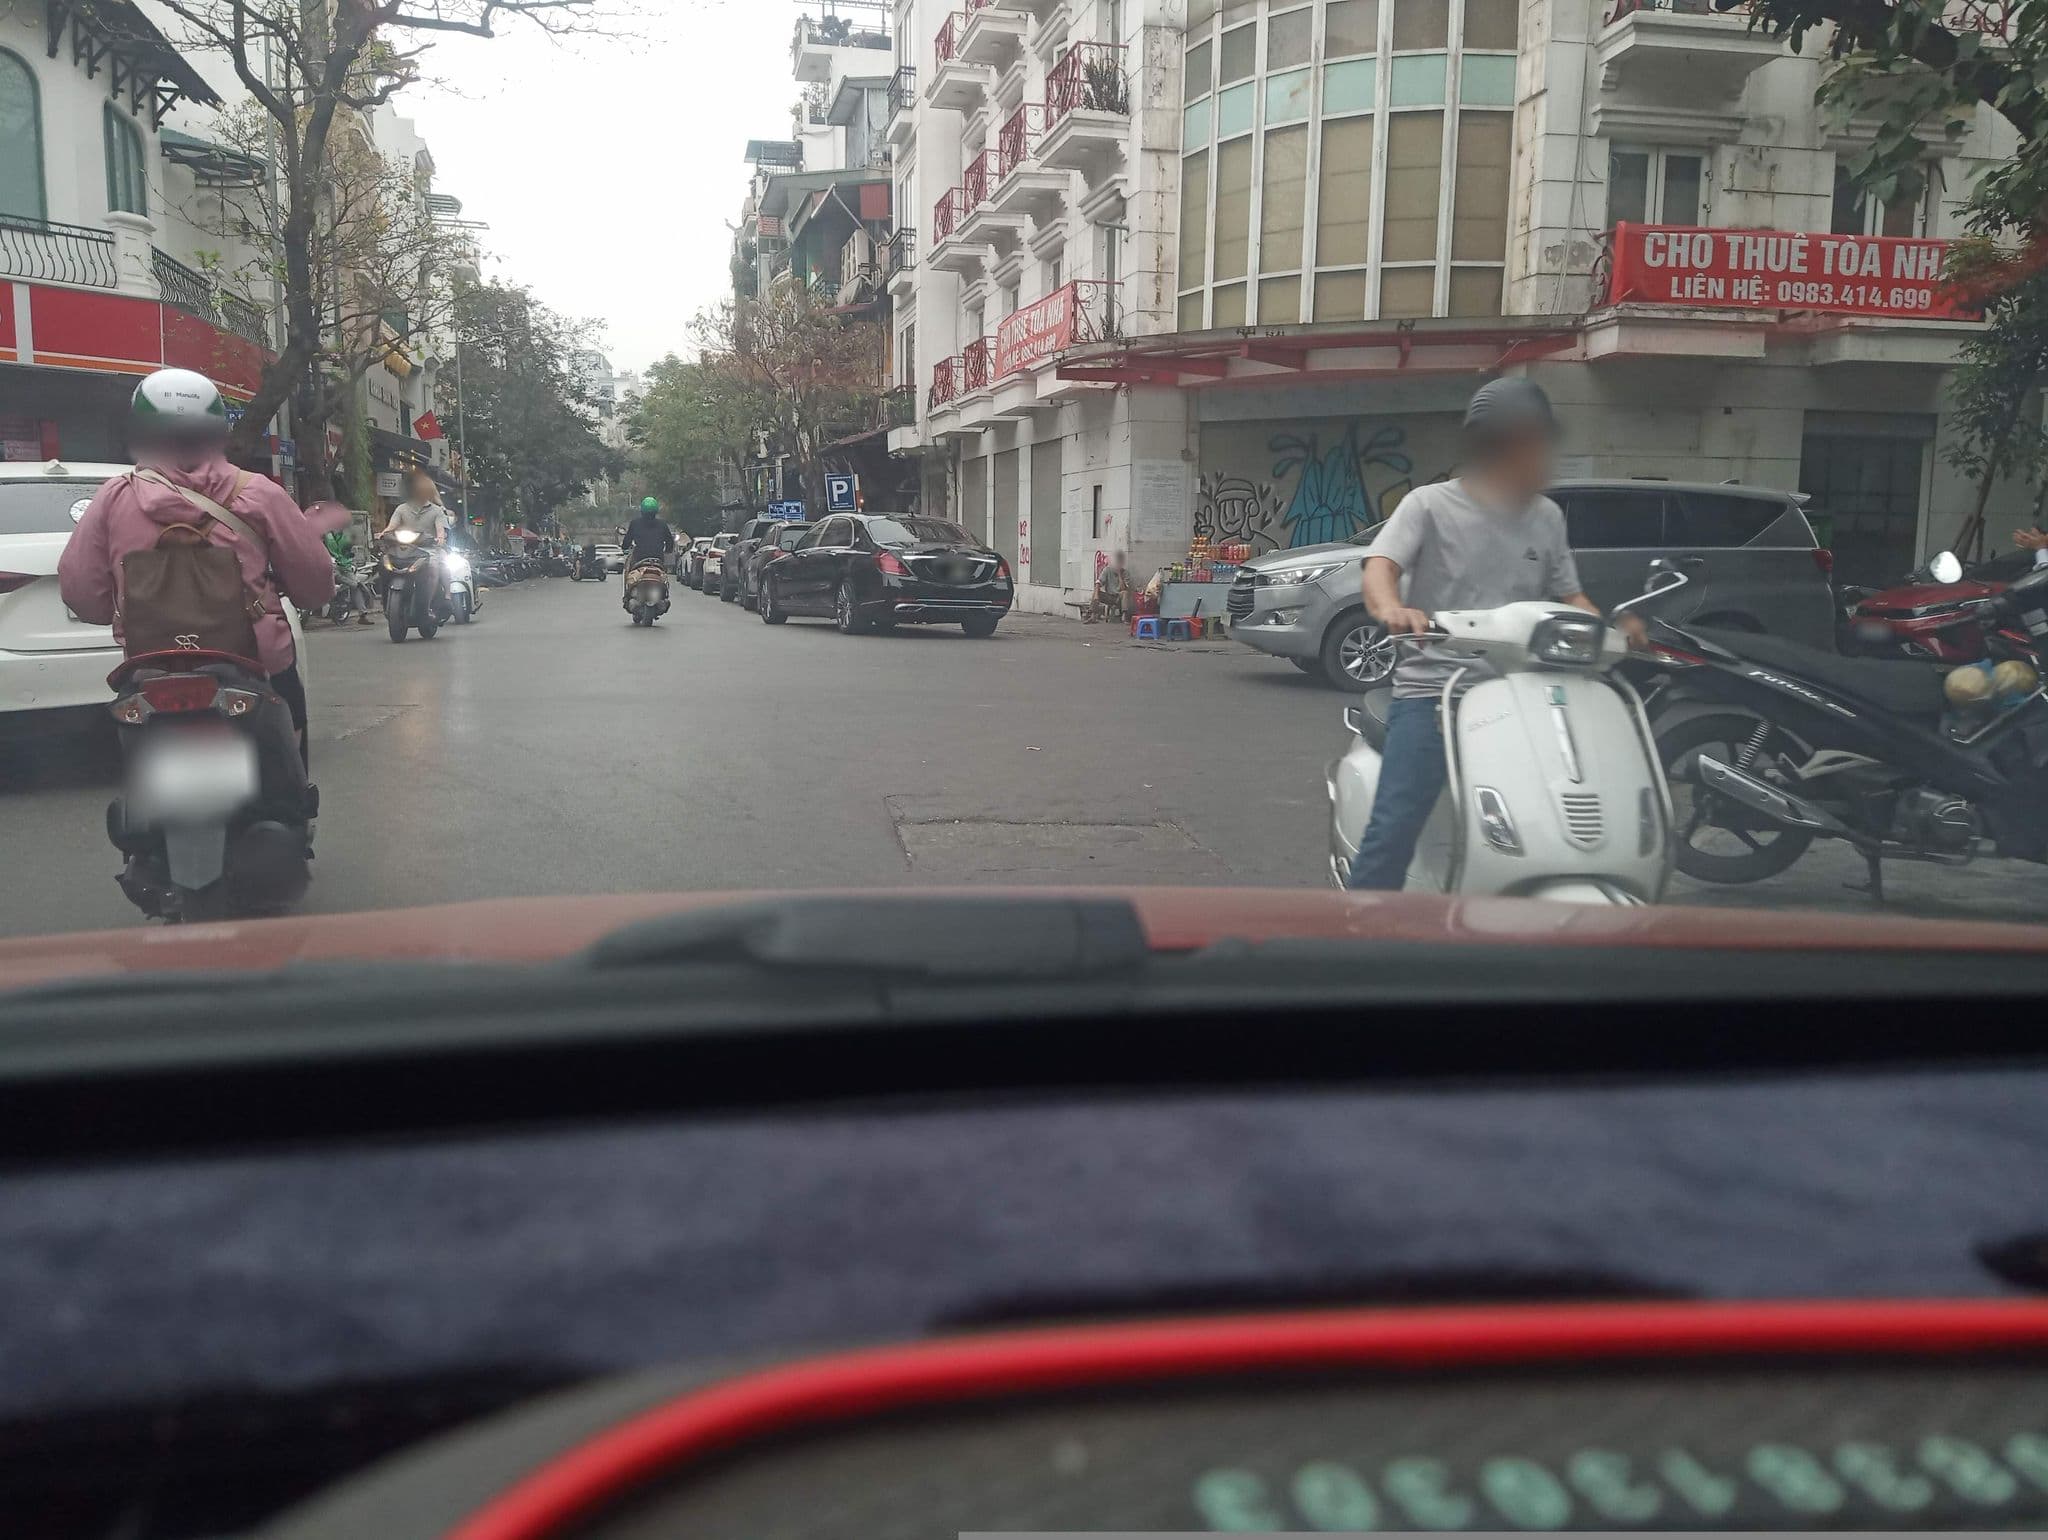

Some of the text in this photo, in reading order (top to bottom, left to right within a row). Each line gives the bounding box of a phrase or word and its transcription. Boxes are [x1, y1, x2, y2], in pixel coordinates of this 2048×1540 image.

[1644, 232, 1714, 269] CHO
[1725, 232, 1809, 274] THUÊ
[1821, 235, 1882, 278] TÒA
[1671, 272, 1932, 310] LIÊN HỆ: 0983.414.699
[832, 480, 849, 502] P
